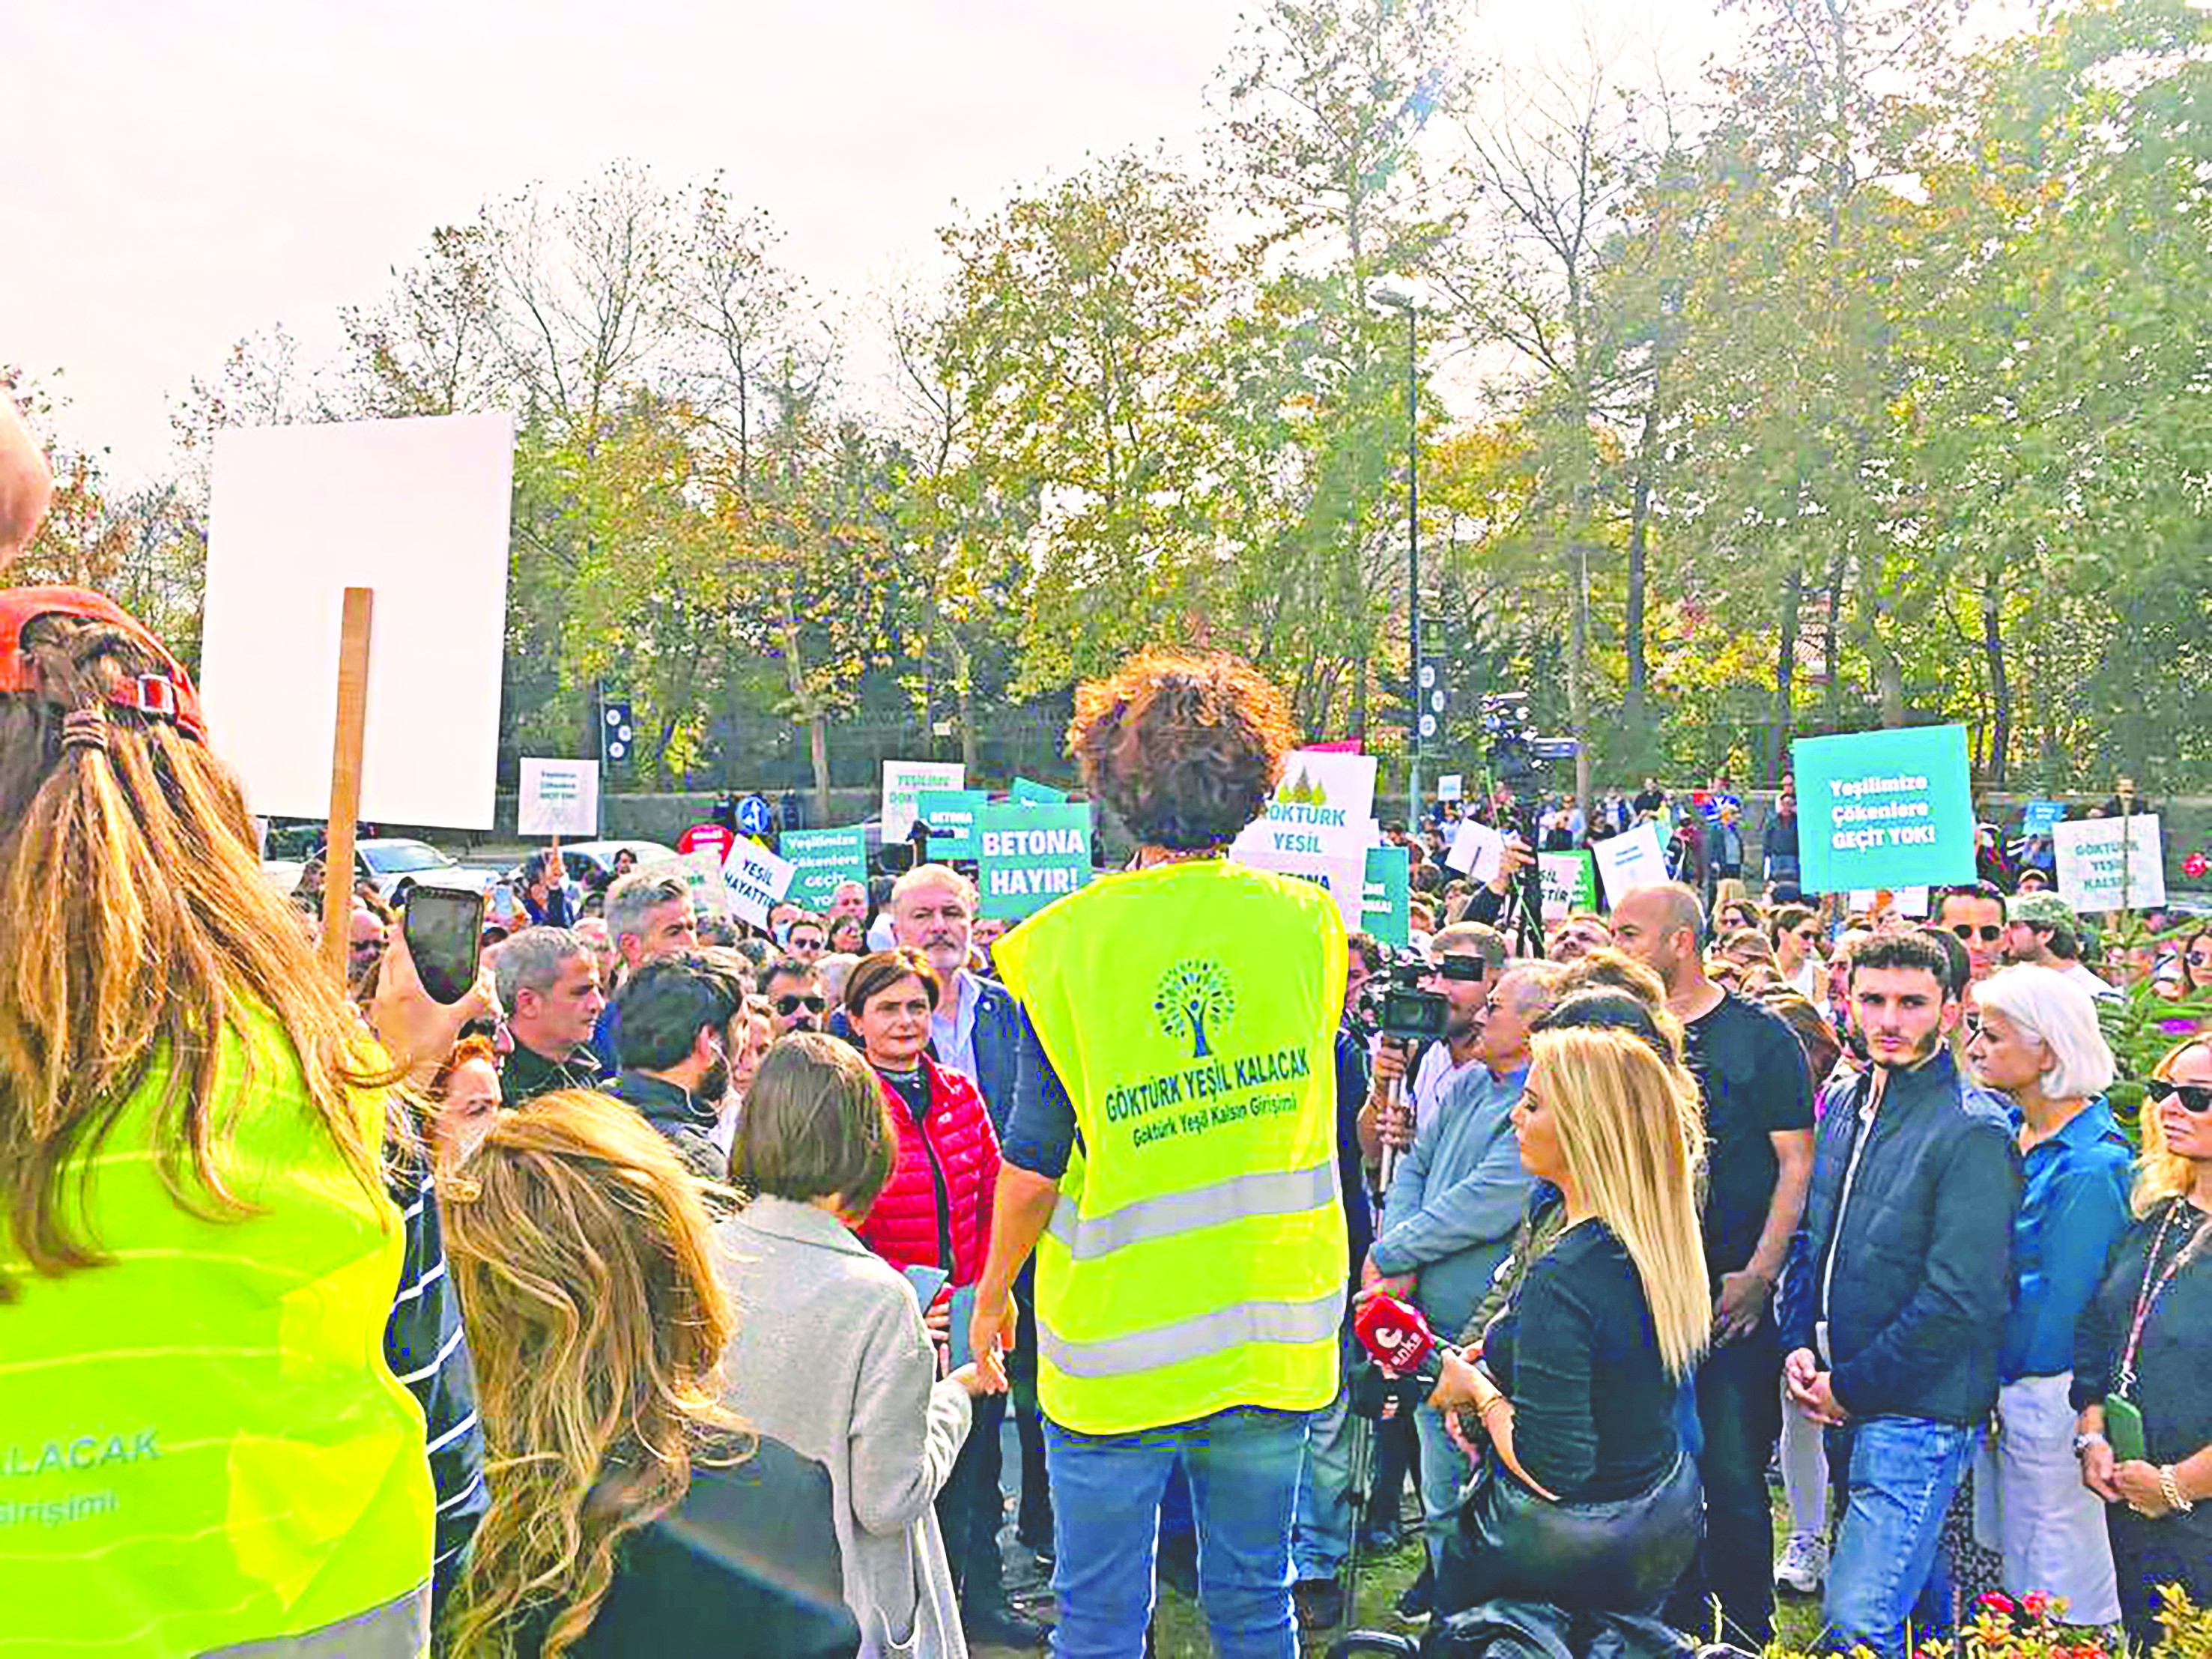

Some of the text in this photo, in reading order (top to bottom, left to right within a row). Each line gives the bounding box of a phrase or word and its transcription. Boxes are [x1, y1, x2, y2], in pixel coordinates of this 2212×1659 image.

[1830, 775, 1928, 799] Yeşilimize
[1267, 803, 1346, 827] ÖKTÜRK
[1831, 801, 1929, 828] Çökenlere
[981, 829, 1085, 857] BETONA
[1832, 825, 1936, 852] GEÇİT YOK!
[990, 867, 1079, 895] HAYIR!
[1106, 1048, 1310, 1122] GÖKTÜRK YEŞİL KALACAK
